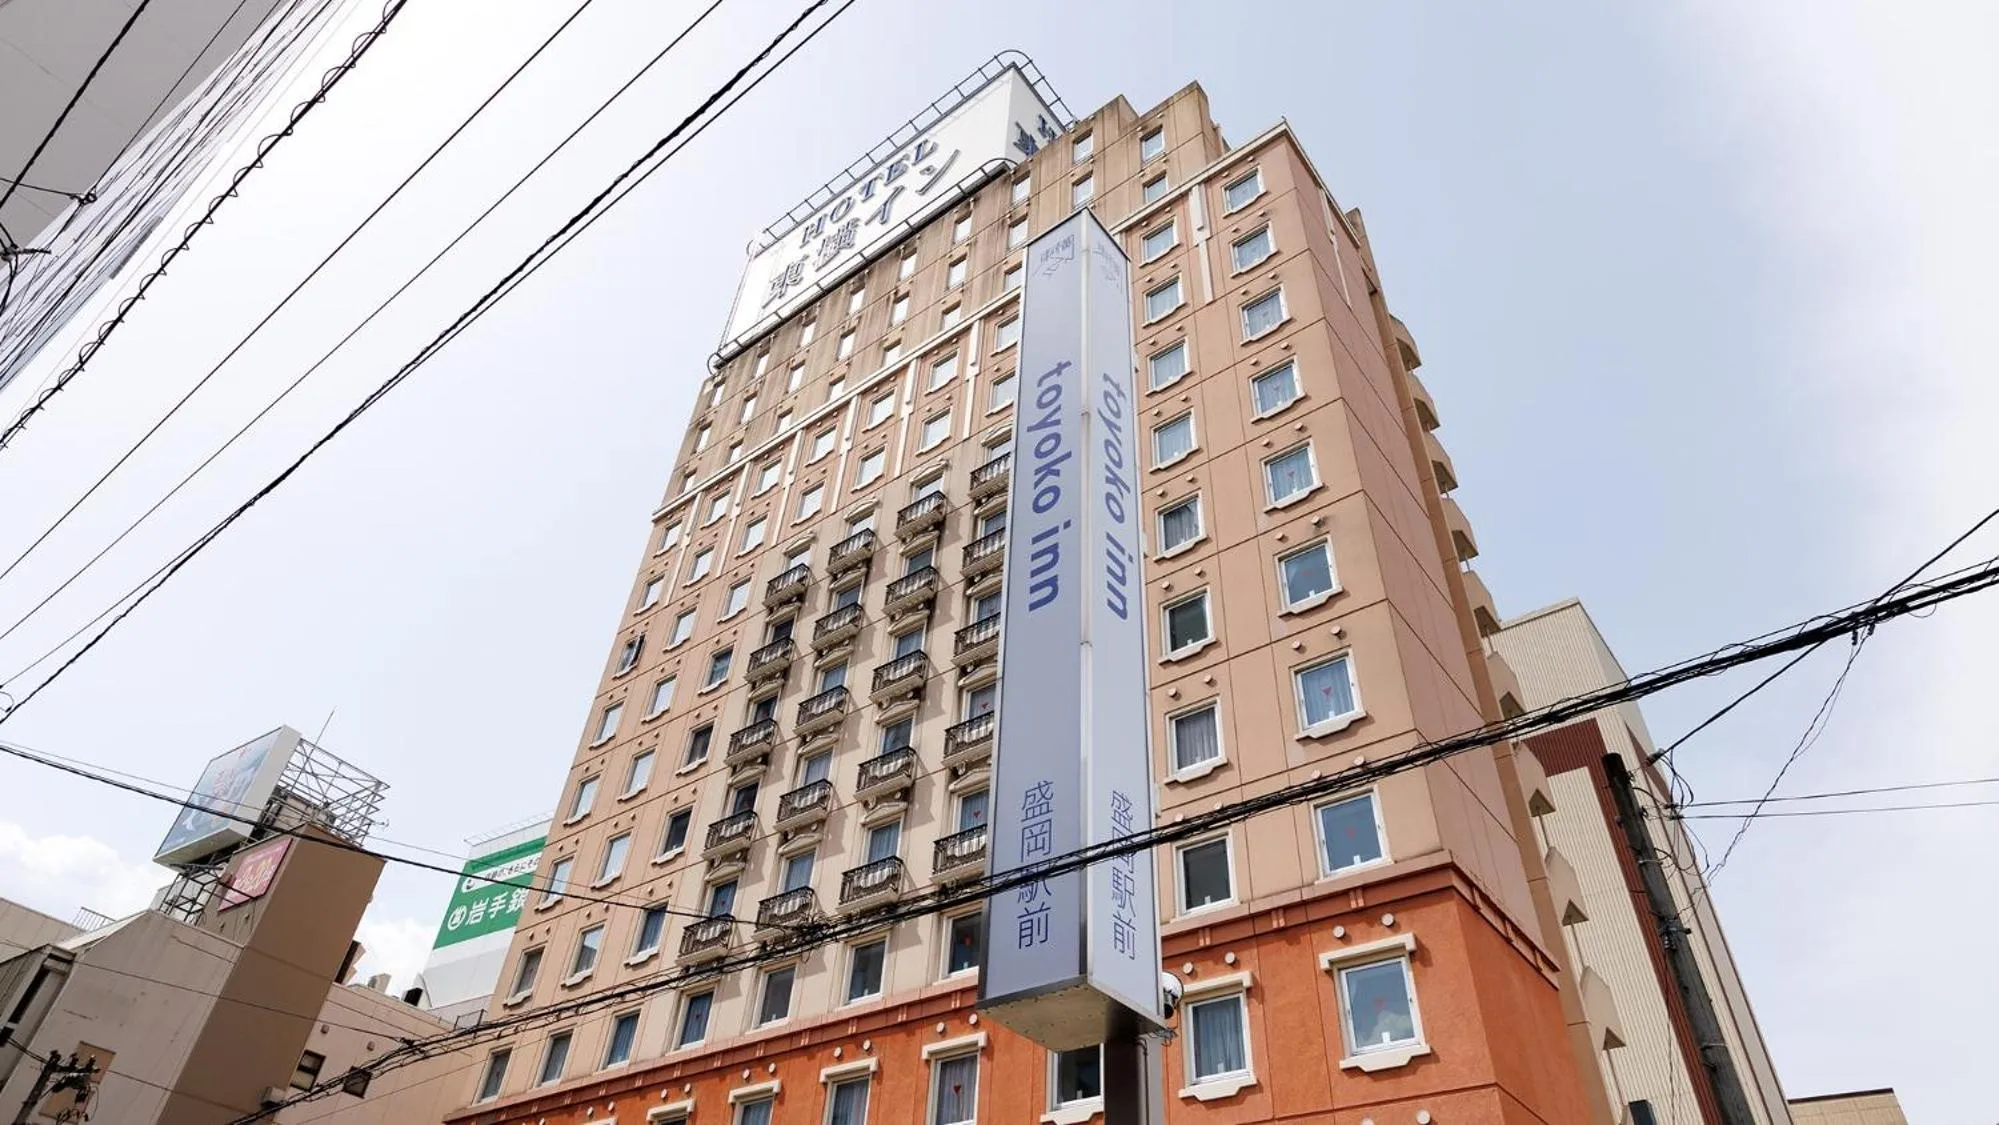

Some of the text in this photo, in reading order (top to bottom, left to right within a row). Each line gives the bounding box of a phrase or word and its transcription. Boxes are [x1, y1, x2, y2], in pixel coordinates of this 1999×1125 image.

[762, 149, 960, 309] 東横イン
[800, 139, 938, 249] HOTEL
[1027, 360, 1072, 612] toyoko inn
[1097, 373, 1134, 621] toyoko inn
